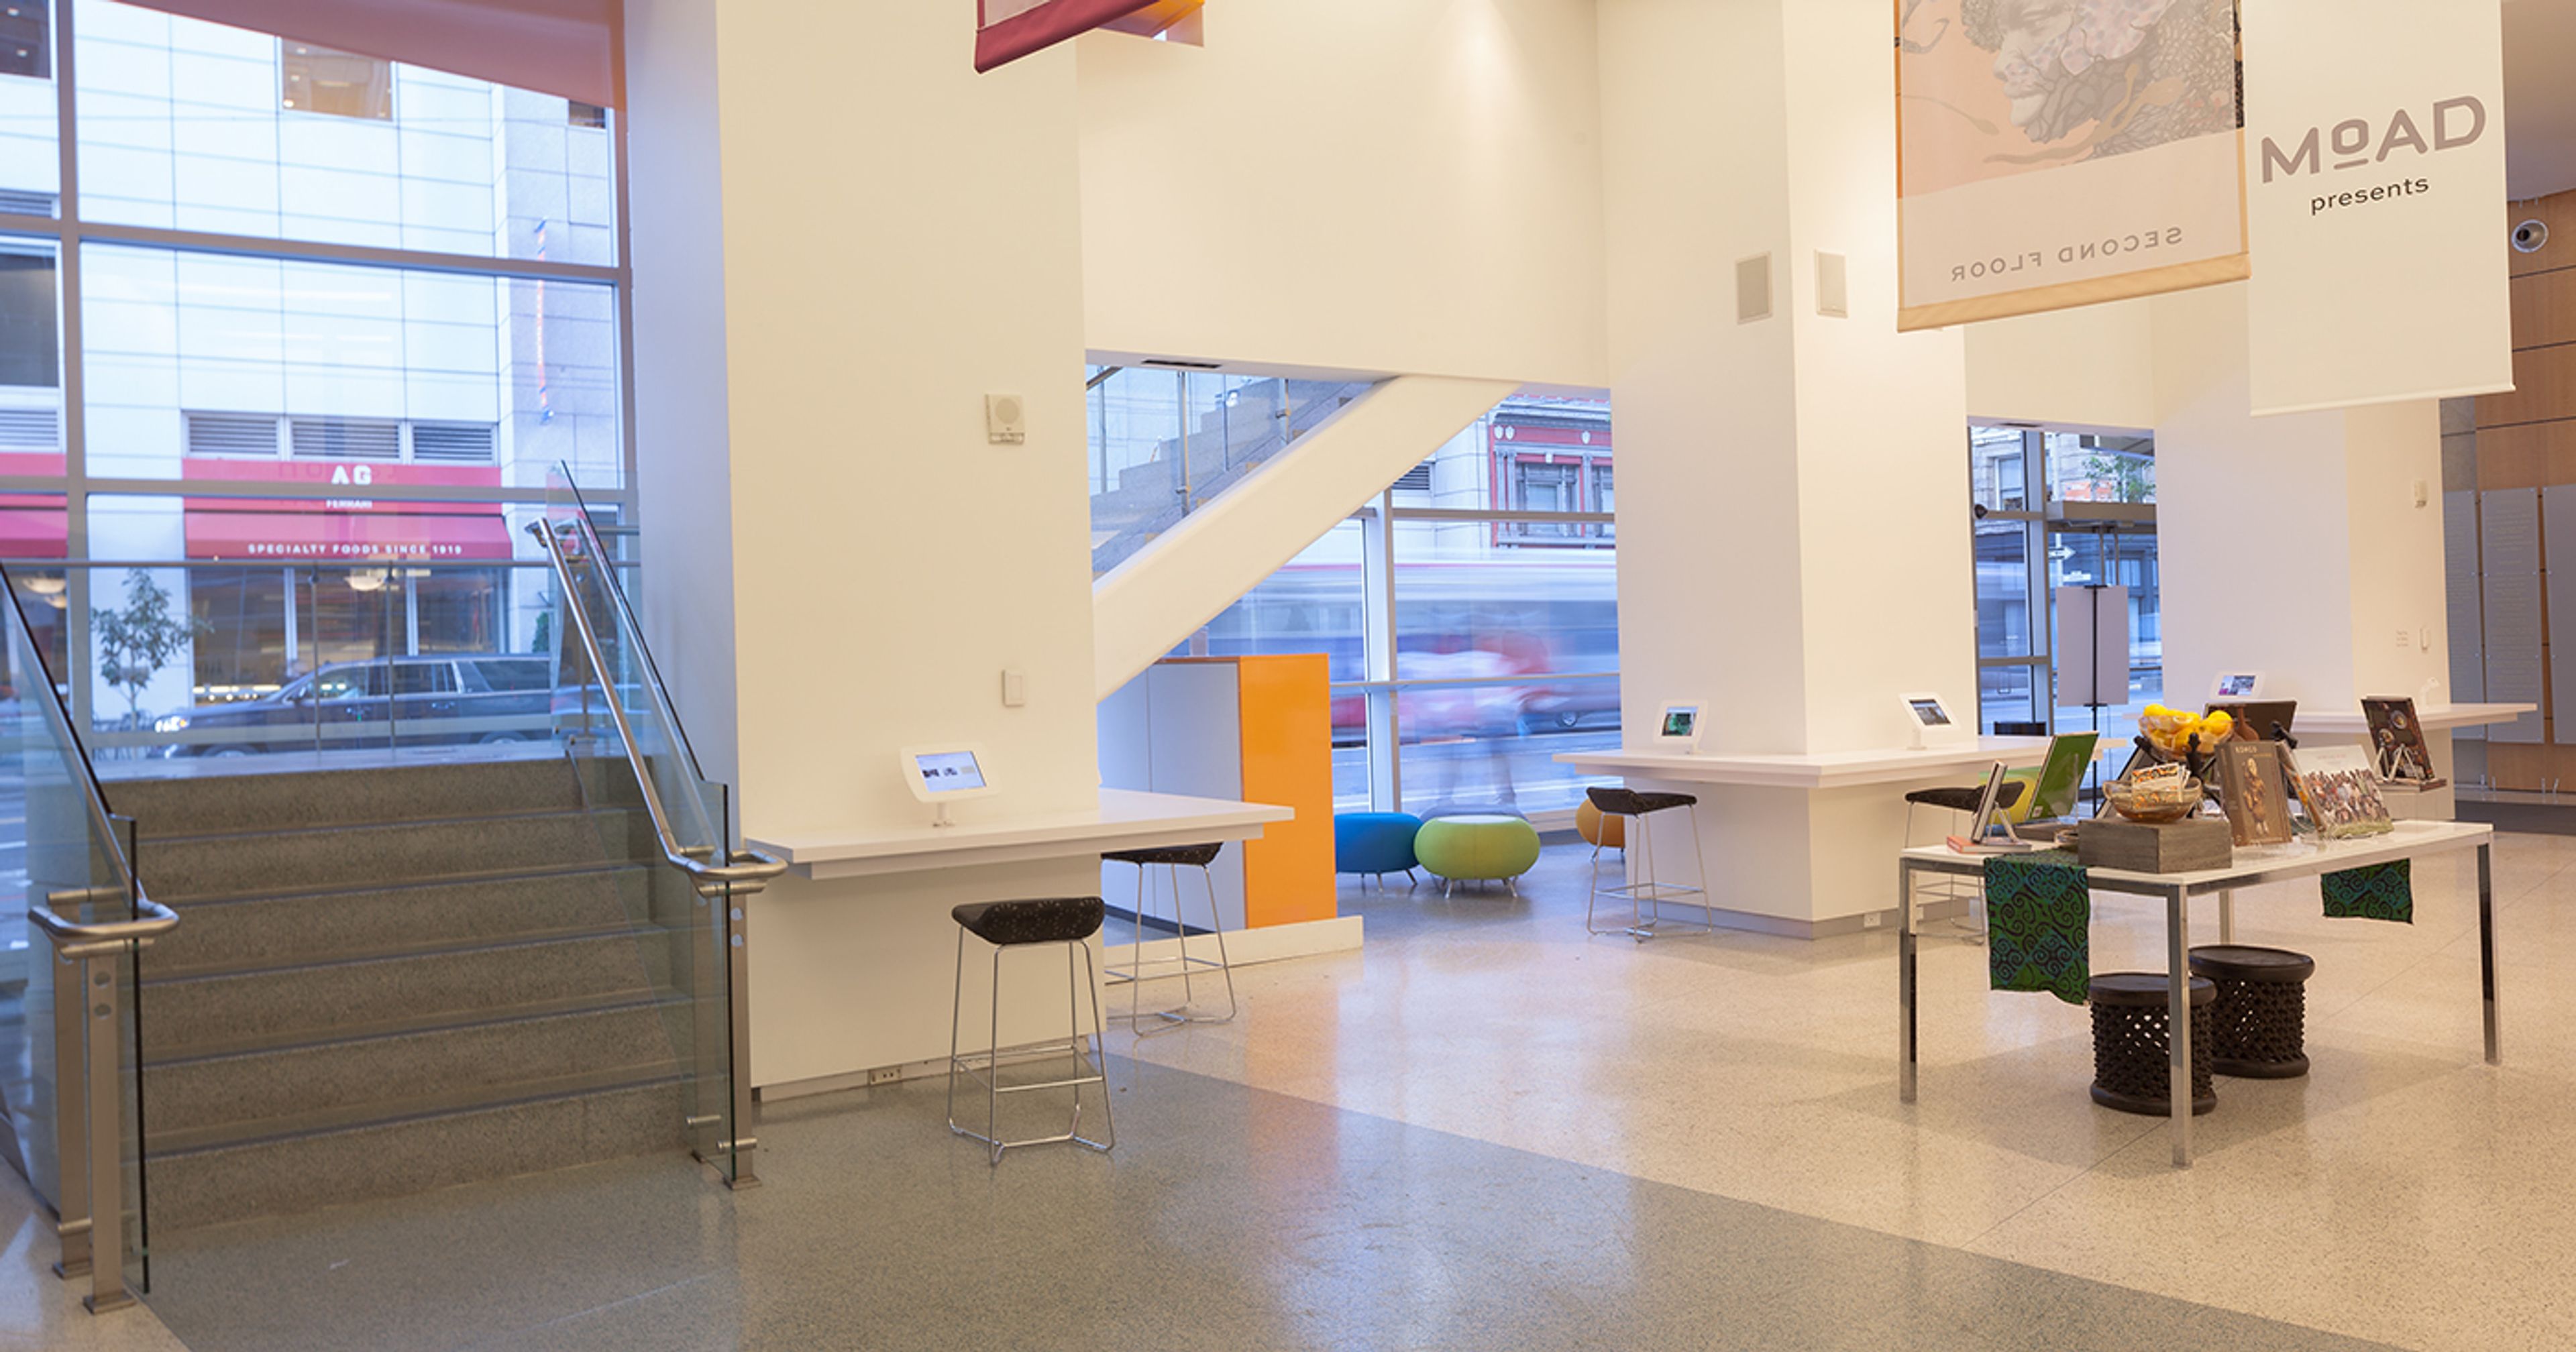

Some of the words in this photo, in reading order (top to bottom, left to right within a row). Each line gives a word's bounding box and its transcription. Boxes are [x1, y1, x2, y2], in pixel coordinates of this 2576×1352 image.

[2311, 178, 2429, 215] presents
[331, 465, 372, 485] AG
[248, 544, 326, 554] SPECIALTY
[333, 544, 379, 554] FOODS
[385, 544, 427, 555] SINCE
[433, 545, 462, 555] 1919
